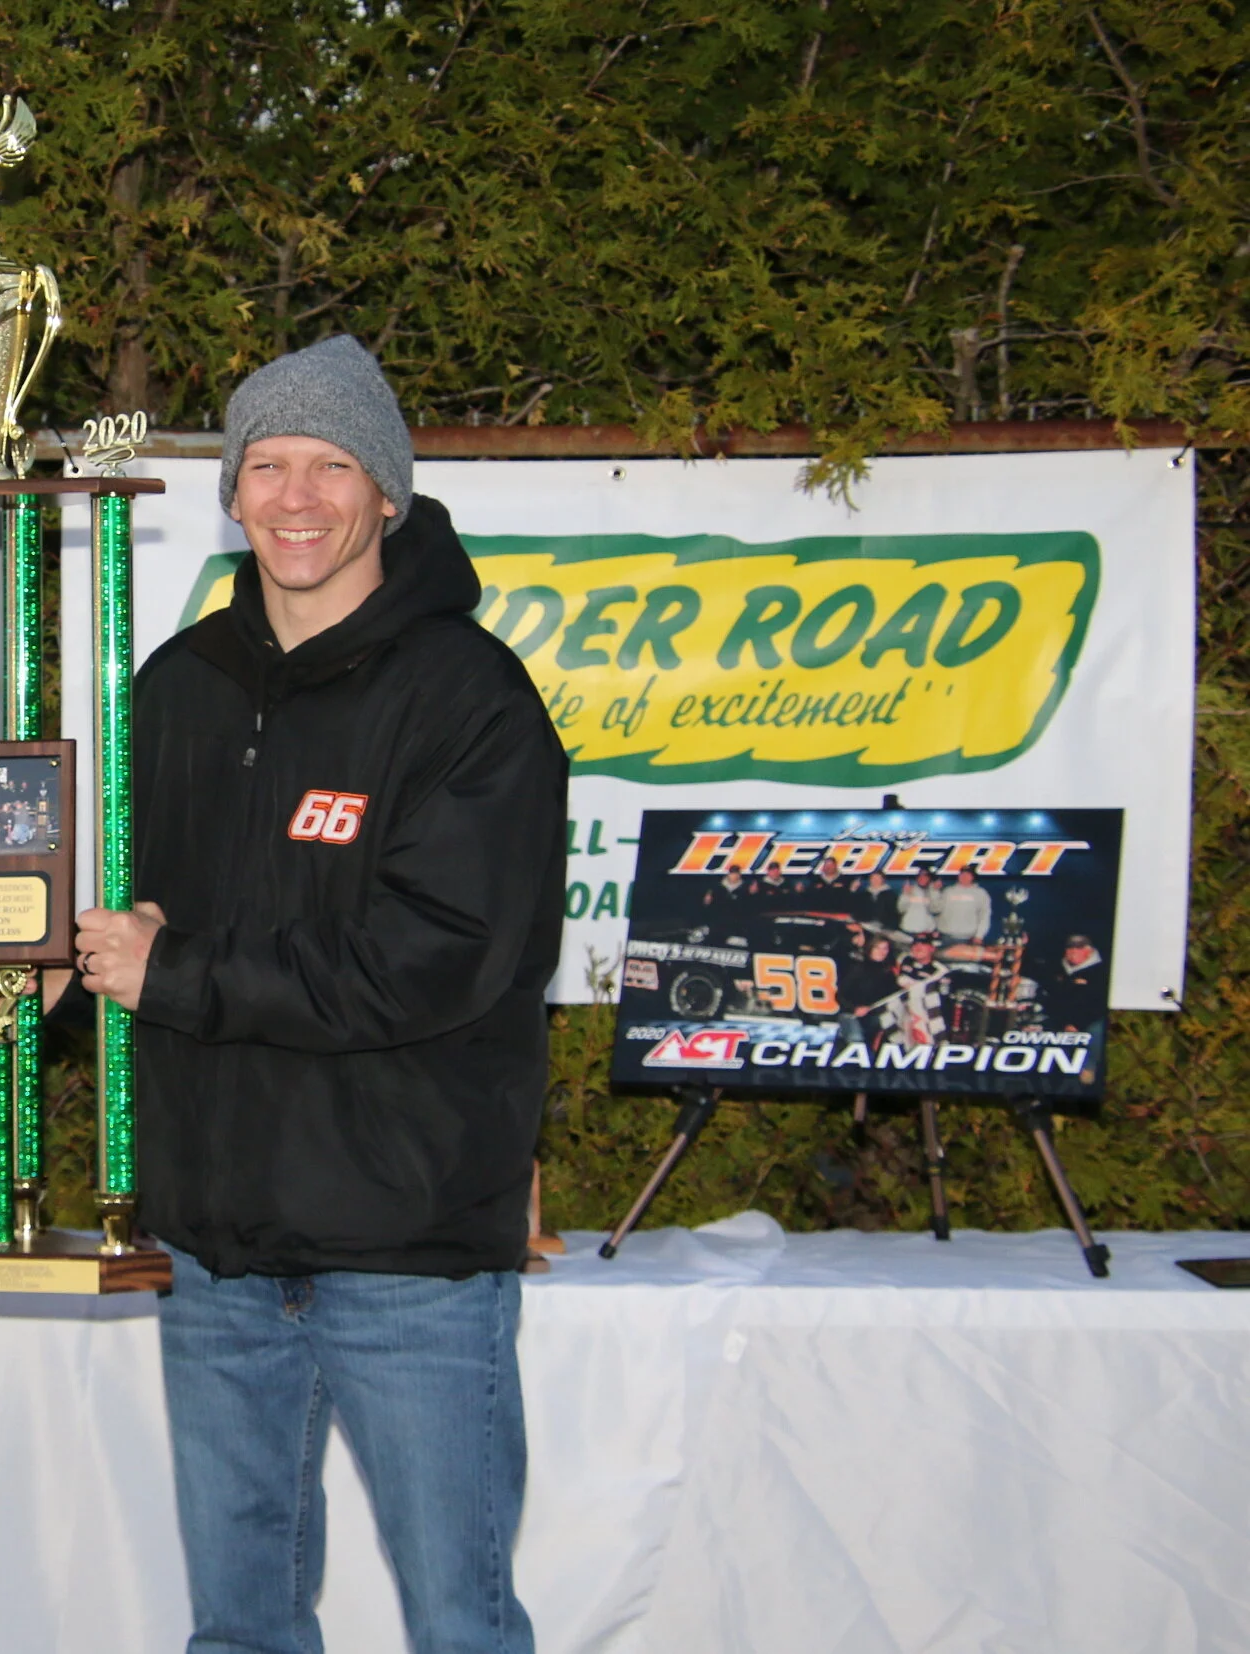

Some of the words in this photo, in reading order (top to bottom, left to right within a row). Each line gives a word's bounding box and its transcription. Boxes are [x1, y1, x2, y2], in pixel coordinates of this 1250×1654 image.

[83, 410, 148, 450] 2020
[478, 584, 702, 671] DER
[716, 580, 1022, 669] ROAD
[602, 674, 658, 738] of
[288, 789, 369, 844] 66
[668, 831, 1091, 875] HEBERT
[752, 953, 840, 1015] 58
[626, 1026, 666, 1040] 2020
[750, 1040, 1088, 1075] CHAMPION
[1002, 1029, 1092, 1046] OWNER
